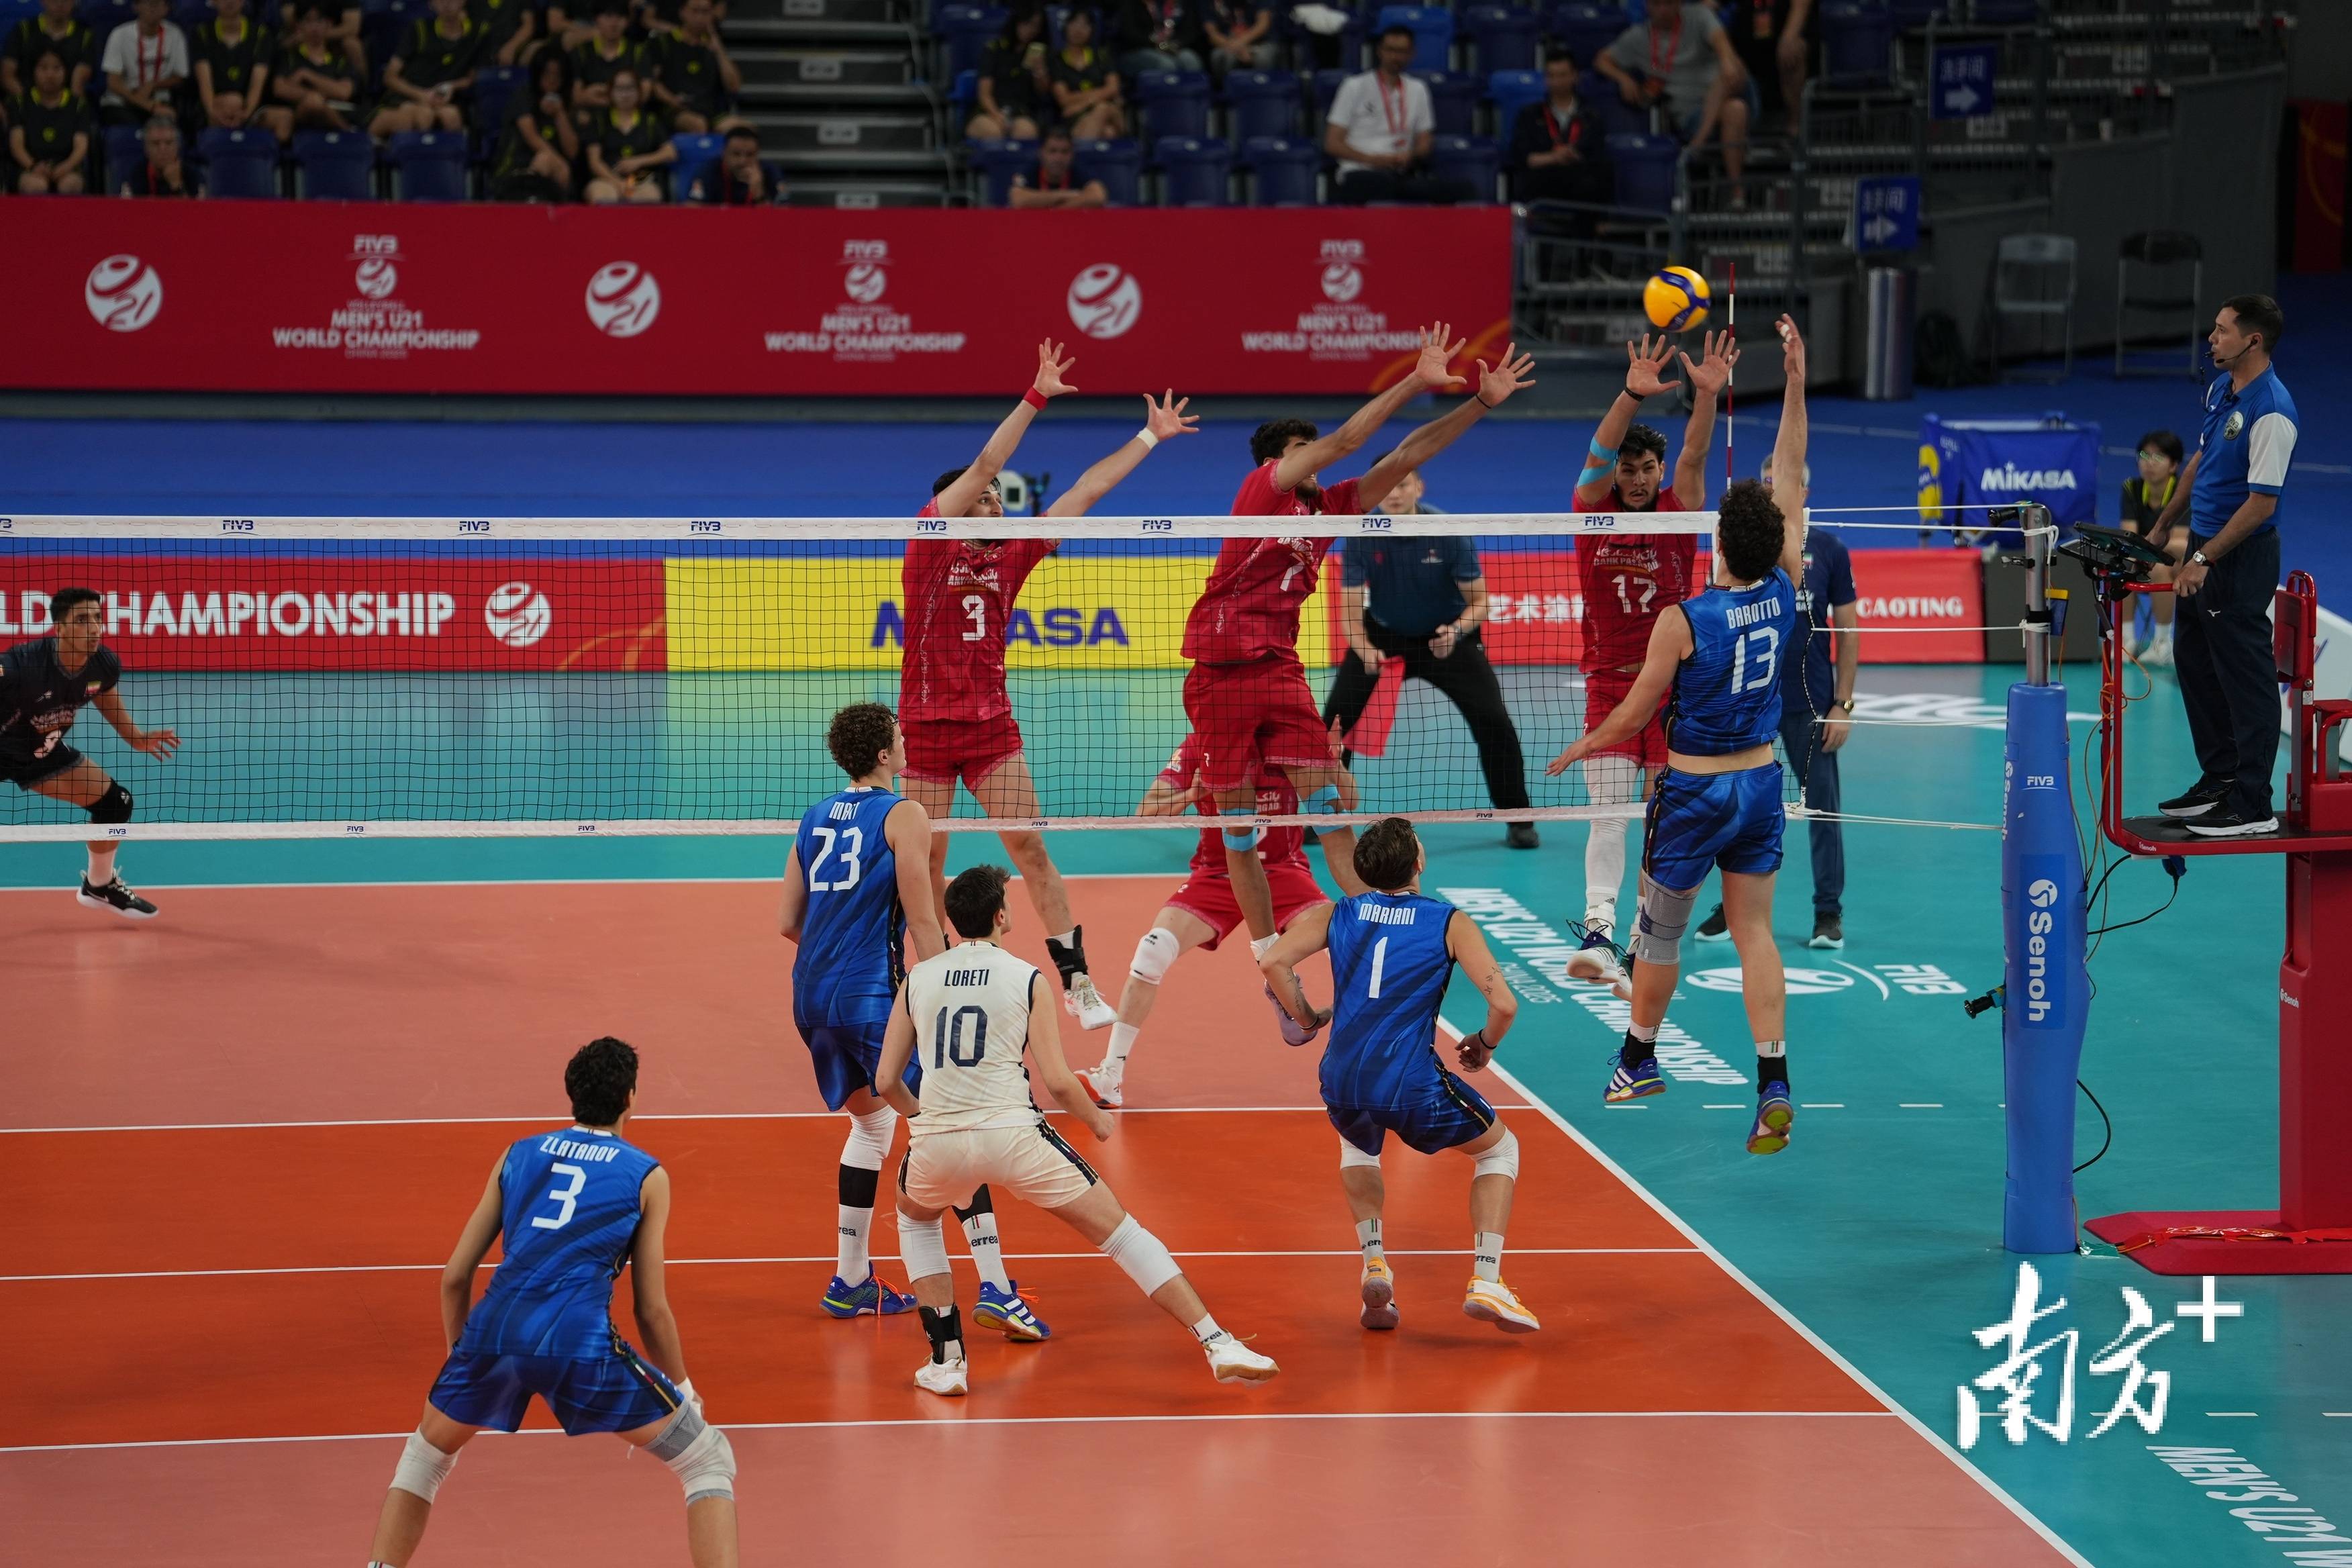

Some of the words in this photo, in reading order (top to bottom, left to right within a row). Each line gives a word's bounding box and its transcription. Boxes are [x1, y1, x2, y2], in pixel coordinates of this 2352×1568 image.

[354, 235, 397, 254] FIVB
[332, 309, 386, 328] MEN'S
[389, 310, 423, 328] U21
[877, 314, 910, 332] U21
[273, 327, 340, 348] WORLD
[344, 329, 480, 349] CHAMPIONSHIP
[765, 332, 831, 351] WORLD
[834, 333, 965, 352] CHAMPIONSHIP
[1242, 332, 1308, 350] WORLD
[224, 520, 254, 530] FIVB
[460, 521, 490, 531] FIVB
[691, 521, 721, 531] FIVB
[918, 521, 947, 530] FIVB
[1142, 520, 1172, 530] FIVB
[1363, 518, 1391, 528] FIVB
[1585, 516, 1614, 526] FIVB
[1612, 575, 1657, 614] 17
[99, 590, 455, 636] HAMPIONSHIP
[962, 595, 985, 641] 3
[1726, 597, 1781, 630] BAROTTO
[1855, 596, 1964, 619] CAOTING
[1730, 626, 1779, 695] 13
[2026, 776, 2054, 786] FIVB
[809, 826, 863, 892] 23
[1358, 903, 1416, 925] MARIANI
[1482, 922, 1567, 944] U21
[1369, 936, 1388, 999] 1
[2028, 911, 2053, 1022] Senoh
[944, 969, 989, 987] LORETI
[935, 1005, 987, 1069] 10
[539, 1135, 620, 1163] ZLATANOV
[531, 1162, 587, 1230] 3
[2145, 1446, 2299, 1502] MEN'S
[2228, 1507, 2352, 1542] U21
